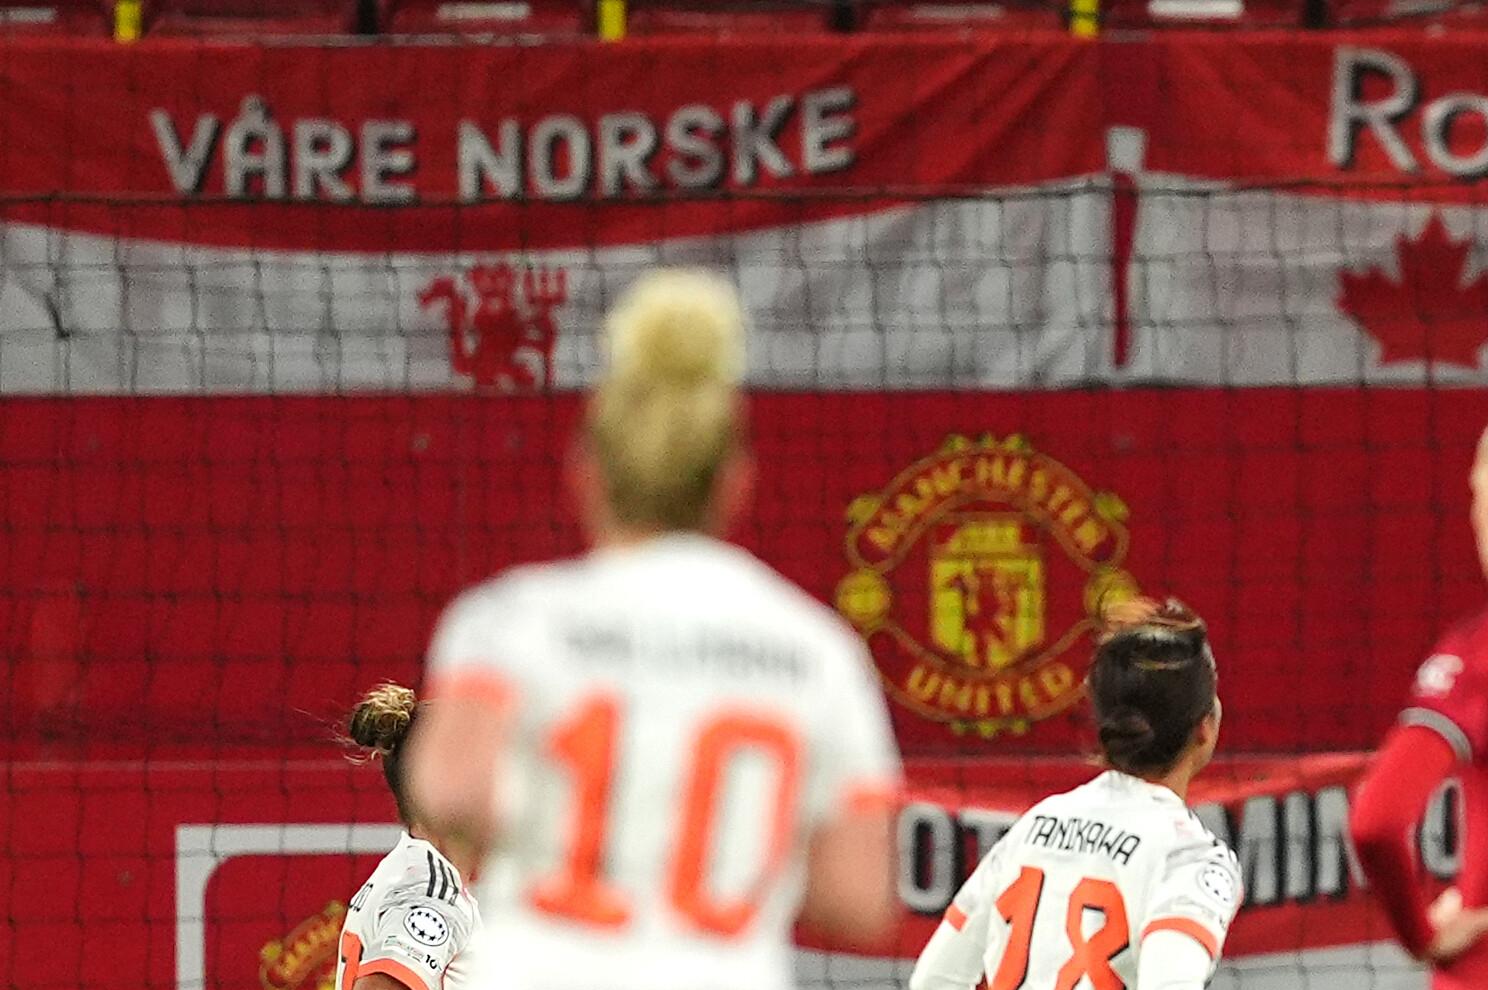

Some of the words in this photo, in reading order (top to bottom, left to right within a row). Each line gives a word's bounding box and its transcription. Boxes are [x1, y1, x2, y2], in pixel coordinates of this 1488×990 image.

[150, 93, 420, 204] VÅRE
[457, 86, 860, 200] NORSKE
[532, 688, 802, 938] 10
[1024, 815, 1141, 866] TANIKAWA
